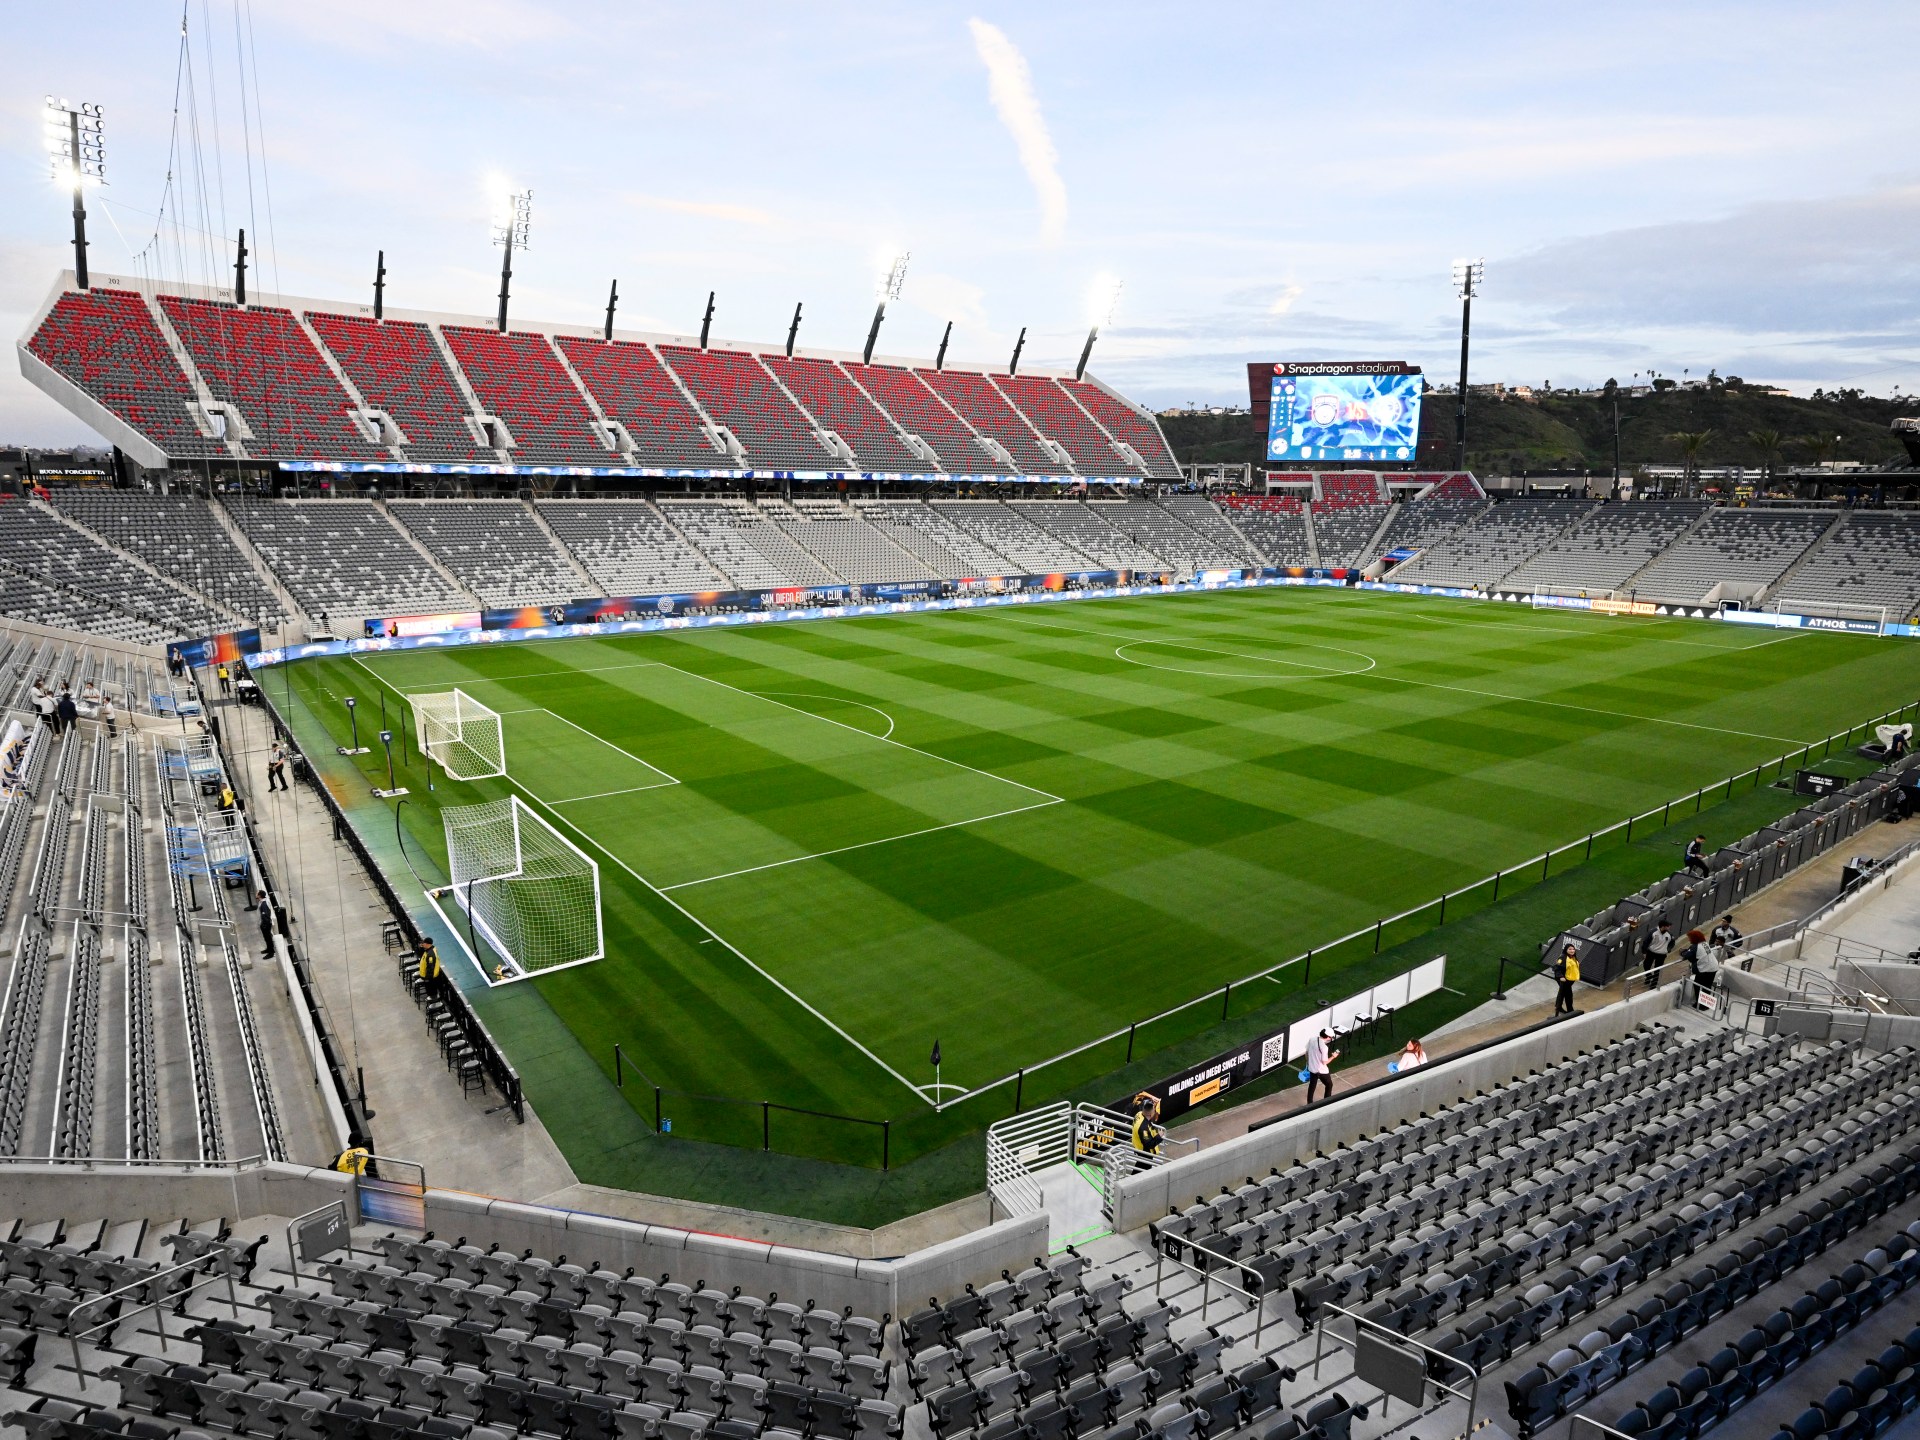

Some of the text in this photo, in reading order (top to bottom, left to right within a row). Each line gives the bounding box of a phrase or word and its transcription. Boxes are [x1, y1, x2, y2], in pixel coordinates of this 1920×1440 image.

[108, 277, 121, 286] 202
[1288, 363, 1400, 375] Snapdragon stadium
[760, 593, 774, 604] SAN
[775, 592, 794, 603] DIEGO
[827, 589, 843, 600] CLUB
[1563, 599, 1590, 607] ULTRA
[1591, 600, 1654, 612] Continental Tire
[1168, 1050, 1251, 1097] BUILDING SAN DIEGO SINCE 1956.
[327, 1220, 339, 1235] 134
